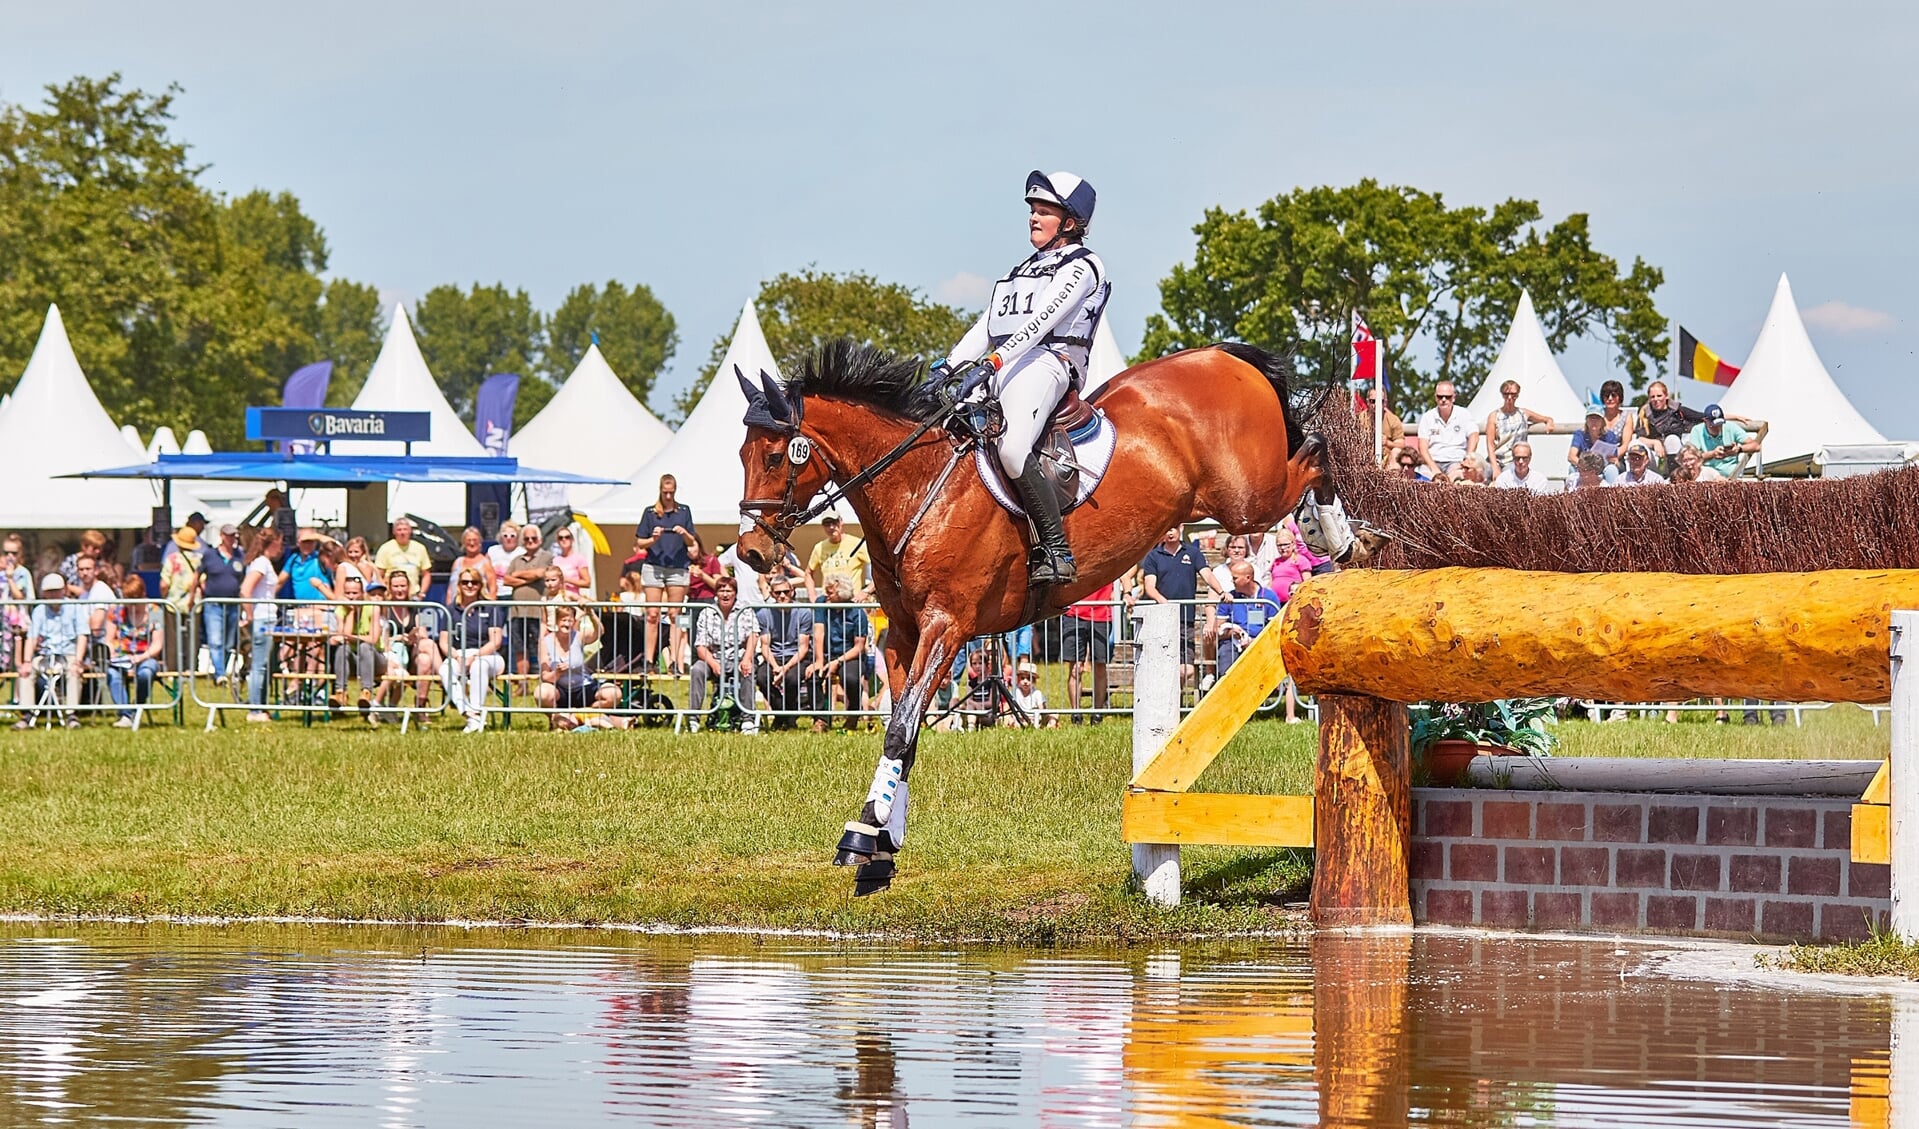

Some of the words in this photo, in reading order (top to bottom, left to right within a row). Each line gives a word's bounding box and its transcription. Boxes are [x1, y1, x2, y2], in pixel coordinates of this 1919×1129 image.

[998, 292, 1034, 317] 311
[1003, 265, 1085, 352] lucygroenen.nl
[325, 414, 385, 435] Bavaria
[791, 442, 809, 459] 169
